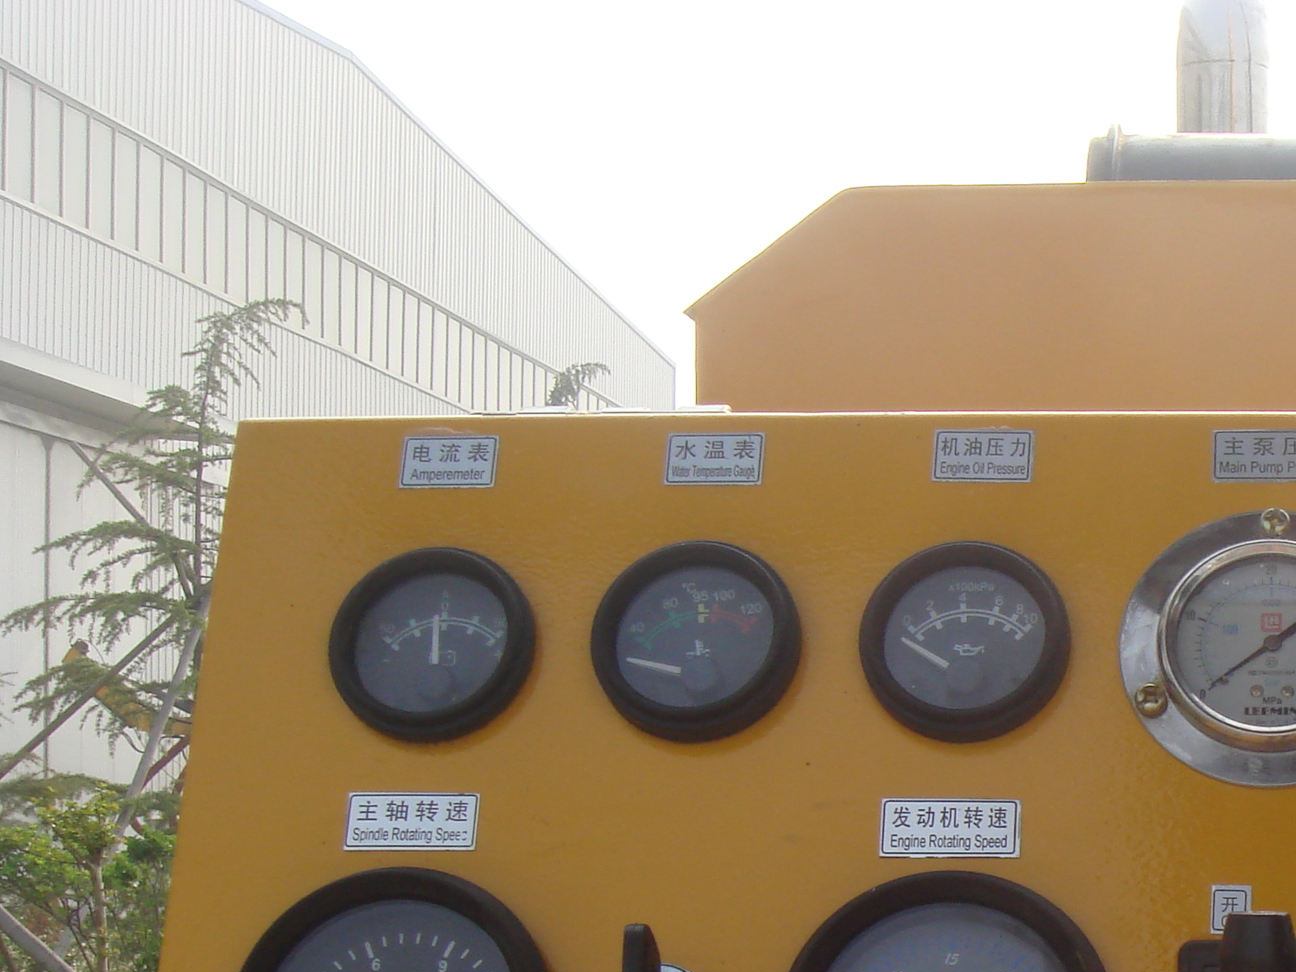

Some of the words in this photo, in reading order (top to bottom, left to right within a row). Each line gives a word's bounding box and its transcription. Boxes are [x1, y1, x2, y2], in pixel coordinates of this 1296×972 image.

[413, 442, 490, 462] 电流表
[675, 440, 755, 460] 水温表
[941, 437, 1026, 457] 机油压力
[671, 465, 690, 477] Water
[692, 465, 732, 478] Temperature
[734, 465, 755, 479] Gauge
[940, 461, 970, 476] Engine
[973, 462, 985, 474] Oil
[987, 462, 1026, 474] Pressure
[1219, 461, 1247, 473] Main
[1250, 461, 1284, 475] Pump
[410, 468, 485, 483] Amperemeter
[692, 590, 708, 602] 95
[713, 589, 736, 601] 100
[959, 592, 967, 601] 4
[994, 595, 1003, 606] 6
[662, 597, 679, 609] 80
[740, 603, 763, 614] 120
[926, 600, 934, 611] 2
[1016, 603, 1024, 614] 8
[902, 615, 911, 626] 0
[1024, 613, 1037, 624] 10
[630, 622, 645, 633] 40
[1262, 696, 1282, 704] MPa
[356, 800, 469, 822] 主轴转速
[892, 806, 1008, 828] 发动机转速
[352, 827, 389, 843] Spindle
[391, 827, 433, 843] Rotating
[890, 834, 926, 851] Engine
[929, 834, 971, 851] Rotating
[974, 834, 1007, 851] Speed
[372, 958, 381, 971] 6
[944, 953, 959, 965] 15
[438, 960, 447, 972] 9
